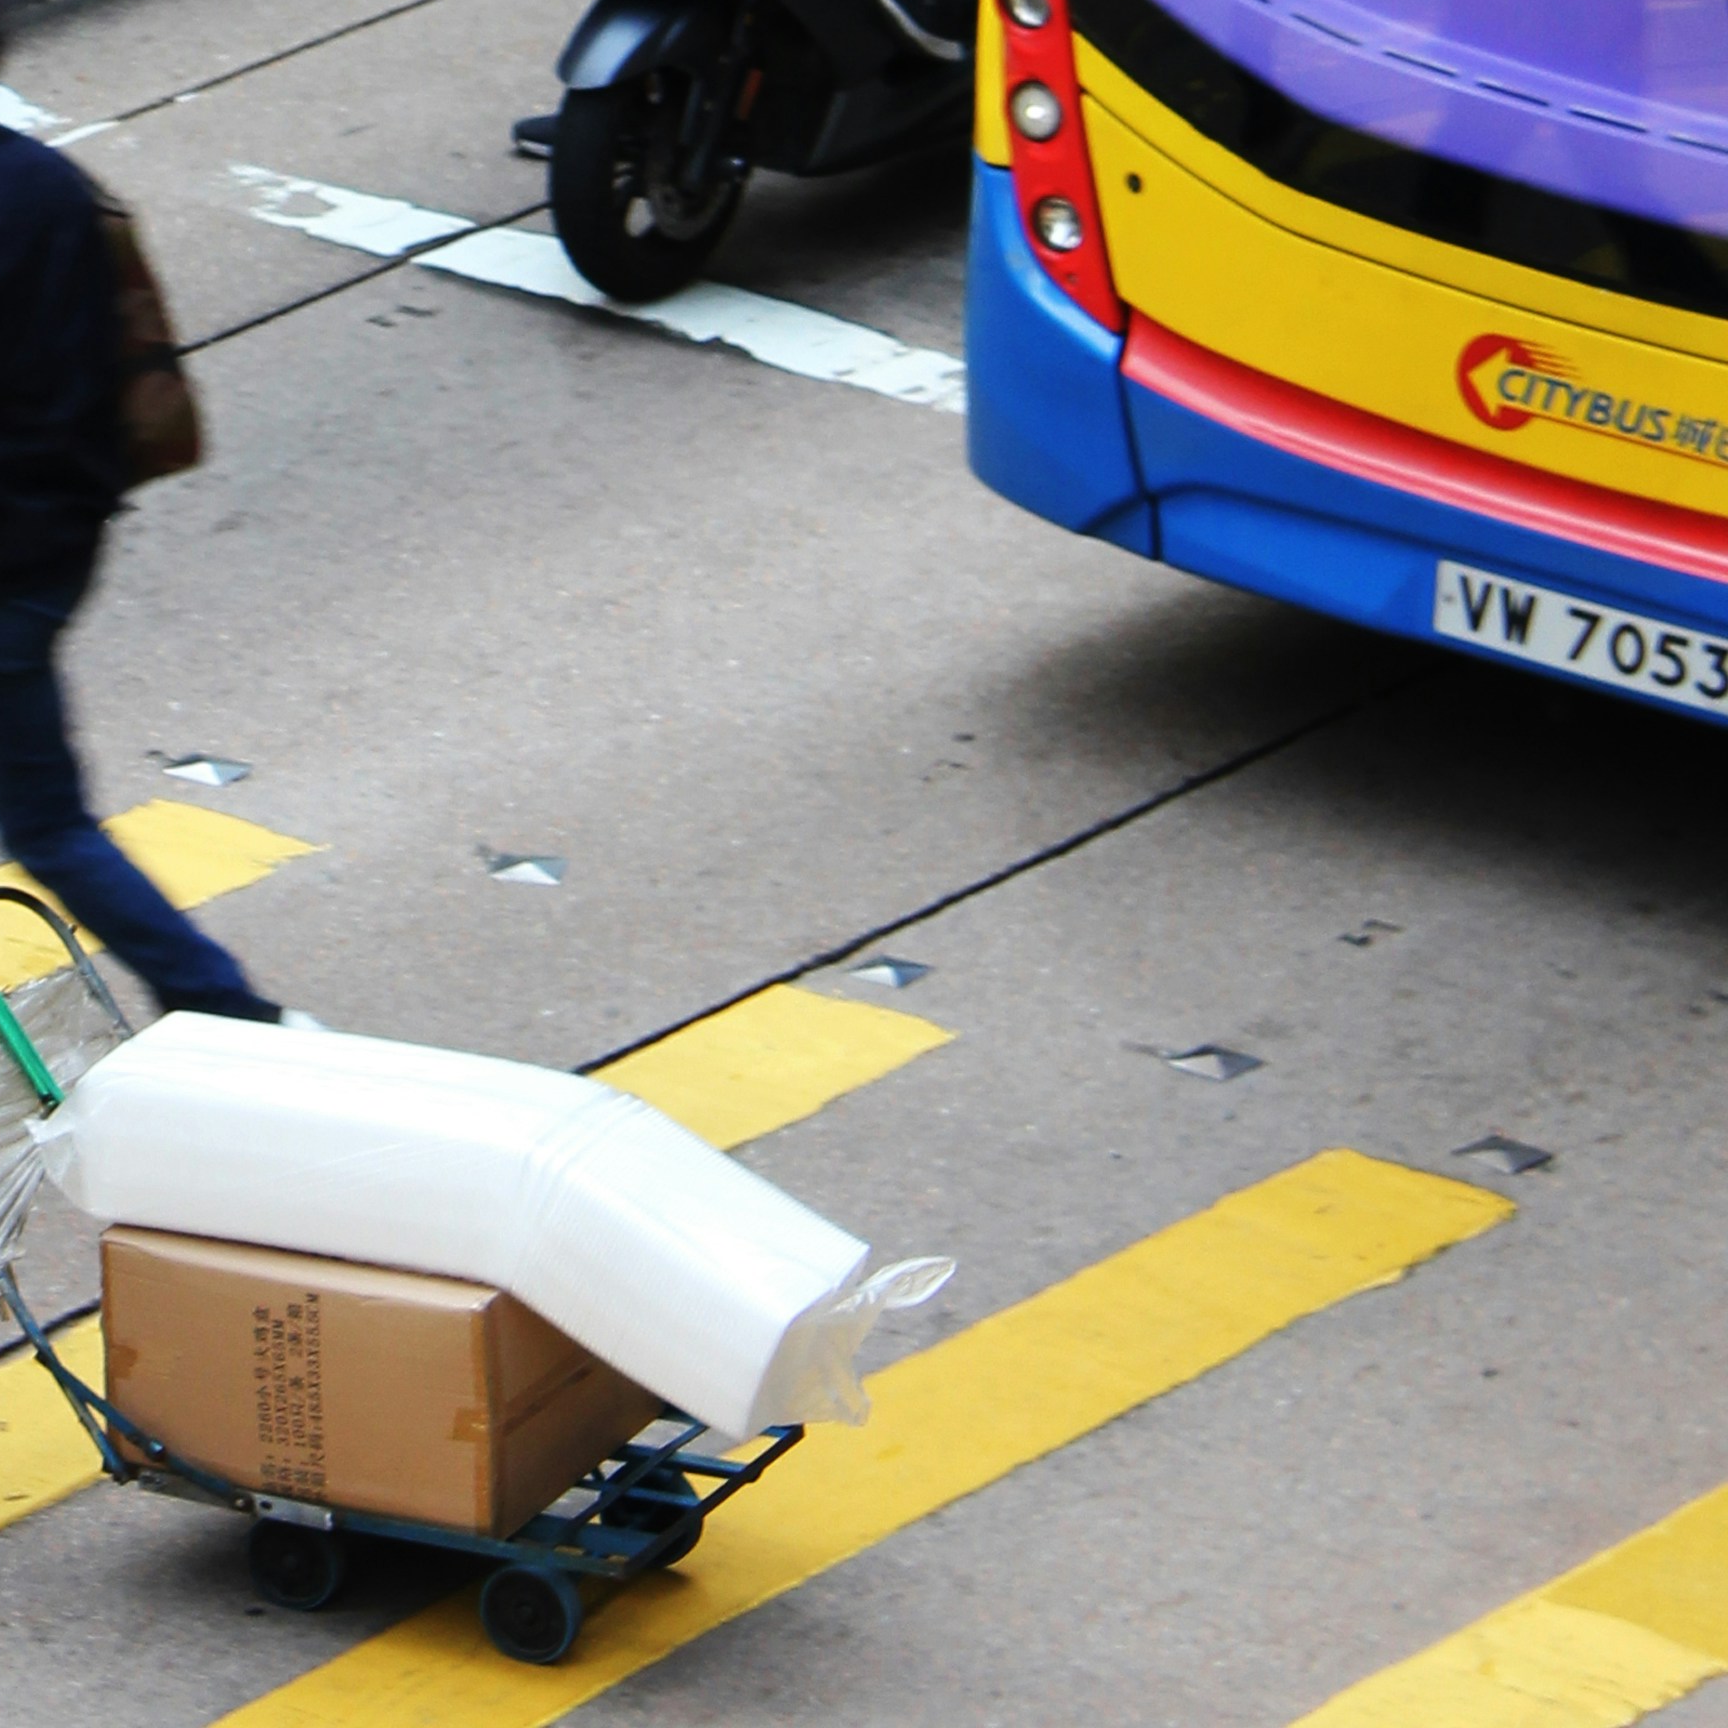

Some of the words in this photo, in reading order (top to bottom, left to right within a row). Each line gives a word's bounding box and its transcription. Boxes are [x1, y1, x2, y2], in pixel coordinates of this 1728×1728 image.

[1495, 366, 1673, 443] CITYBUS
[1459, 573, 1537, 646] VW
[1567, 606, 1728, 701] 7053
